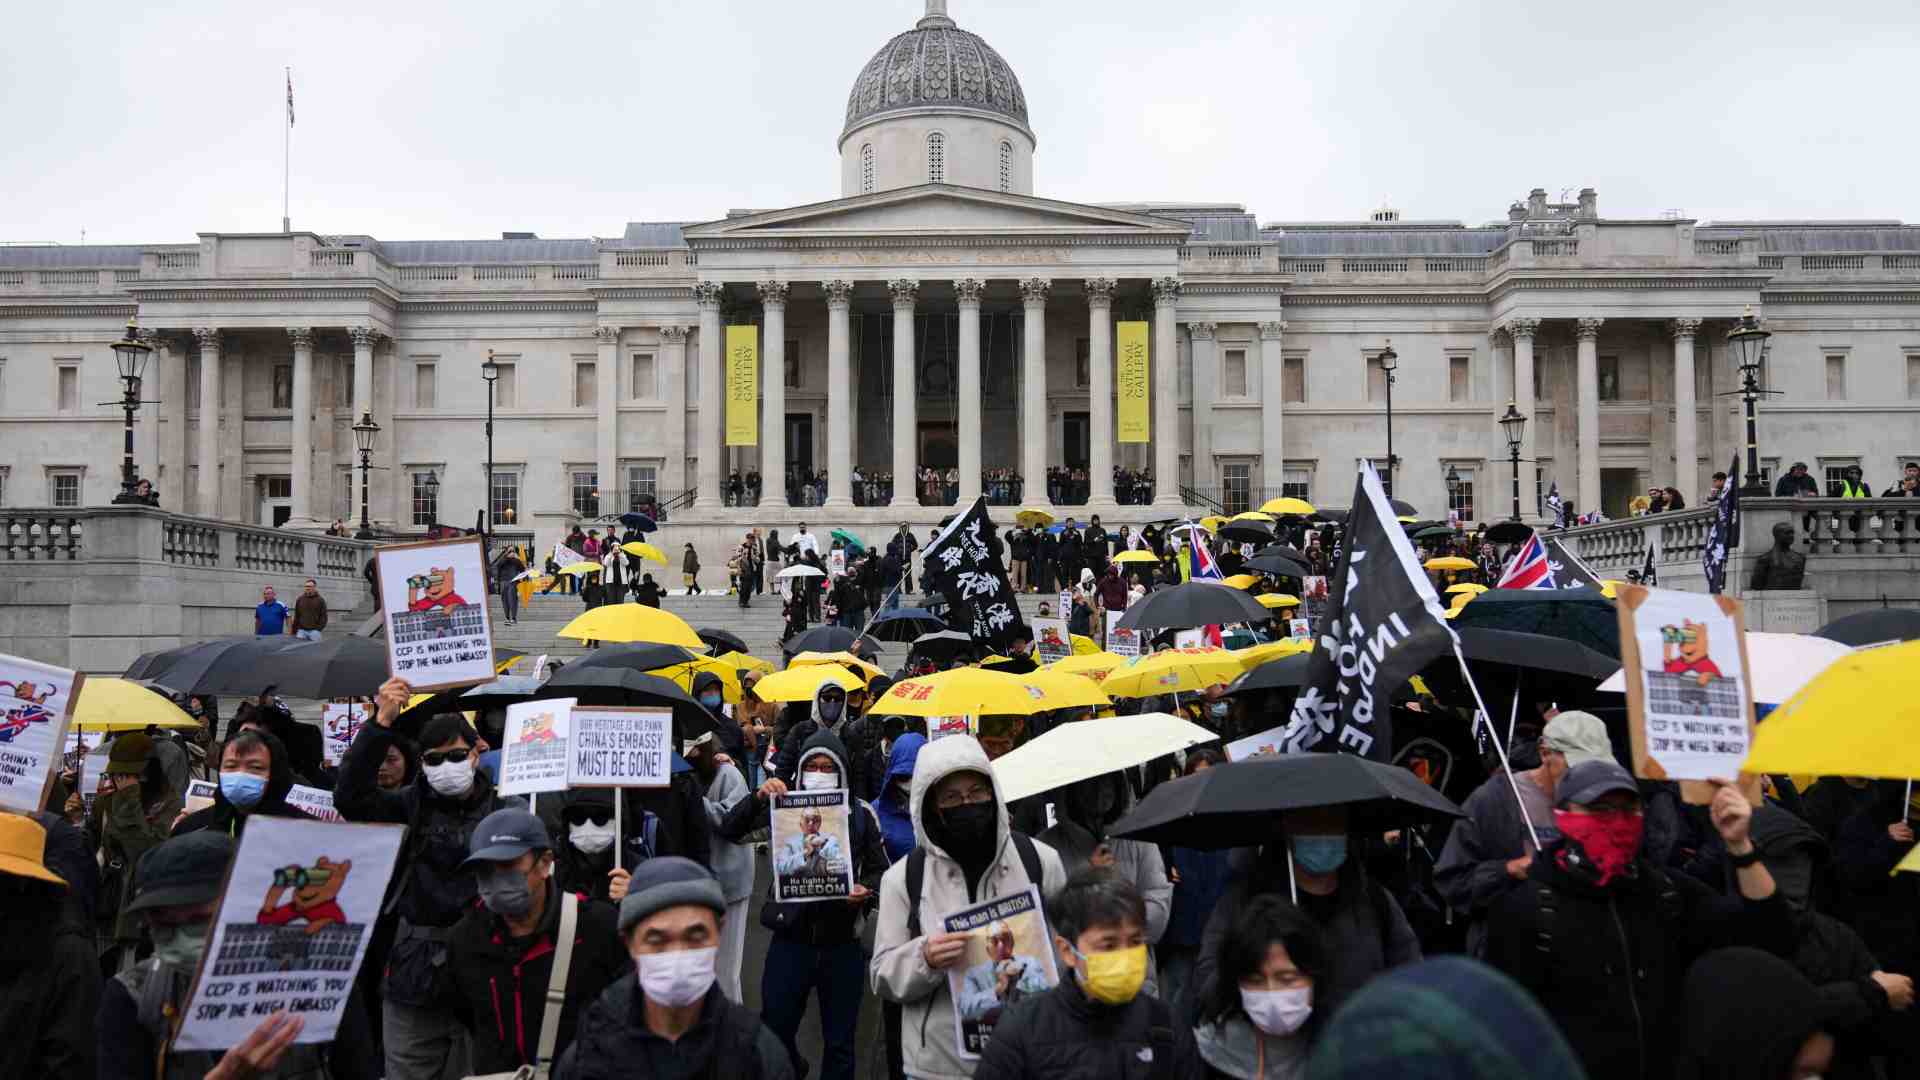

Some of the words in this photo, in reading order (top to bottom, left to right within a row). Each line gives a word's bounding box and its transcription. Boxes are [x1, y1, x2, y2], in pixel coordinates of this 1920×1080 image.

[734, 346, 743, 401] NATIONAL
[743, 345, 752, 402] GALLERY
[1126, 342, 1134, 399] NATIONAL
[1134, 343, 1144, 399] GALLERY
[395, 646, 413, 657] CCP
[416, 644, 424, 654] IS
[427, 639, 468, 653] WATCHING
[472, 638, 488, 648] YOU
[397, 659, 413, 670] STOP
[416, 658, 428, 668] THE
[431, 654, 453, 665] MEGA
[455, 650, 488, 663] EMBASSY
[578, 731, 615, 748] CHINA'S
[618, 732, 663, 749] EMBASSY
[1, 752, 38, 768] CHINA'S
[577, 751, 608, 777] MUST
[611, 751, 625, 777] BE
[628, 751, 662, 777] GONE!
[793, 796, 808, 807] man
[783, 882, 847, 897] FREEDOM
[951, 918, 970, 931] This
[969, 912, 989, 928] man
[989, 906, 998, 919] is
[997, 895, 1031, 917] BRITISH
[205, 981, 234, 998] CCP
[237, 981, 251, 996] IS
[255, 977, 319, 995] WATCHING
[324, 977, 348, 992] YOU
[195, 1003, 227, 1021] STOP
[228, 1002, 249, 1019] THE
[289, 997, 339, 1013] EMBASSY
